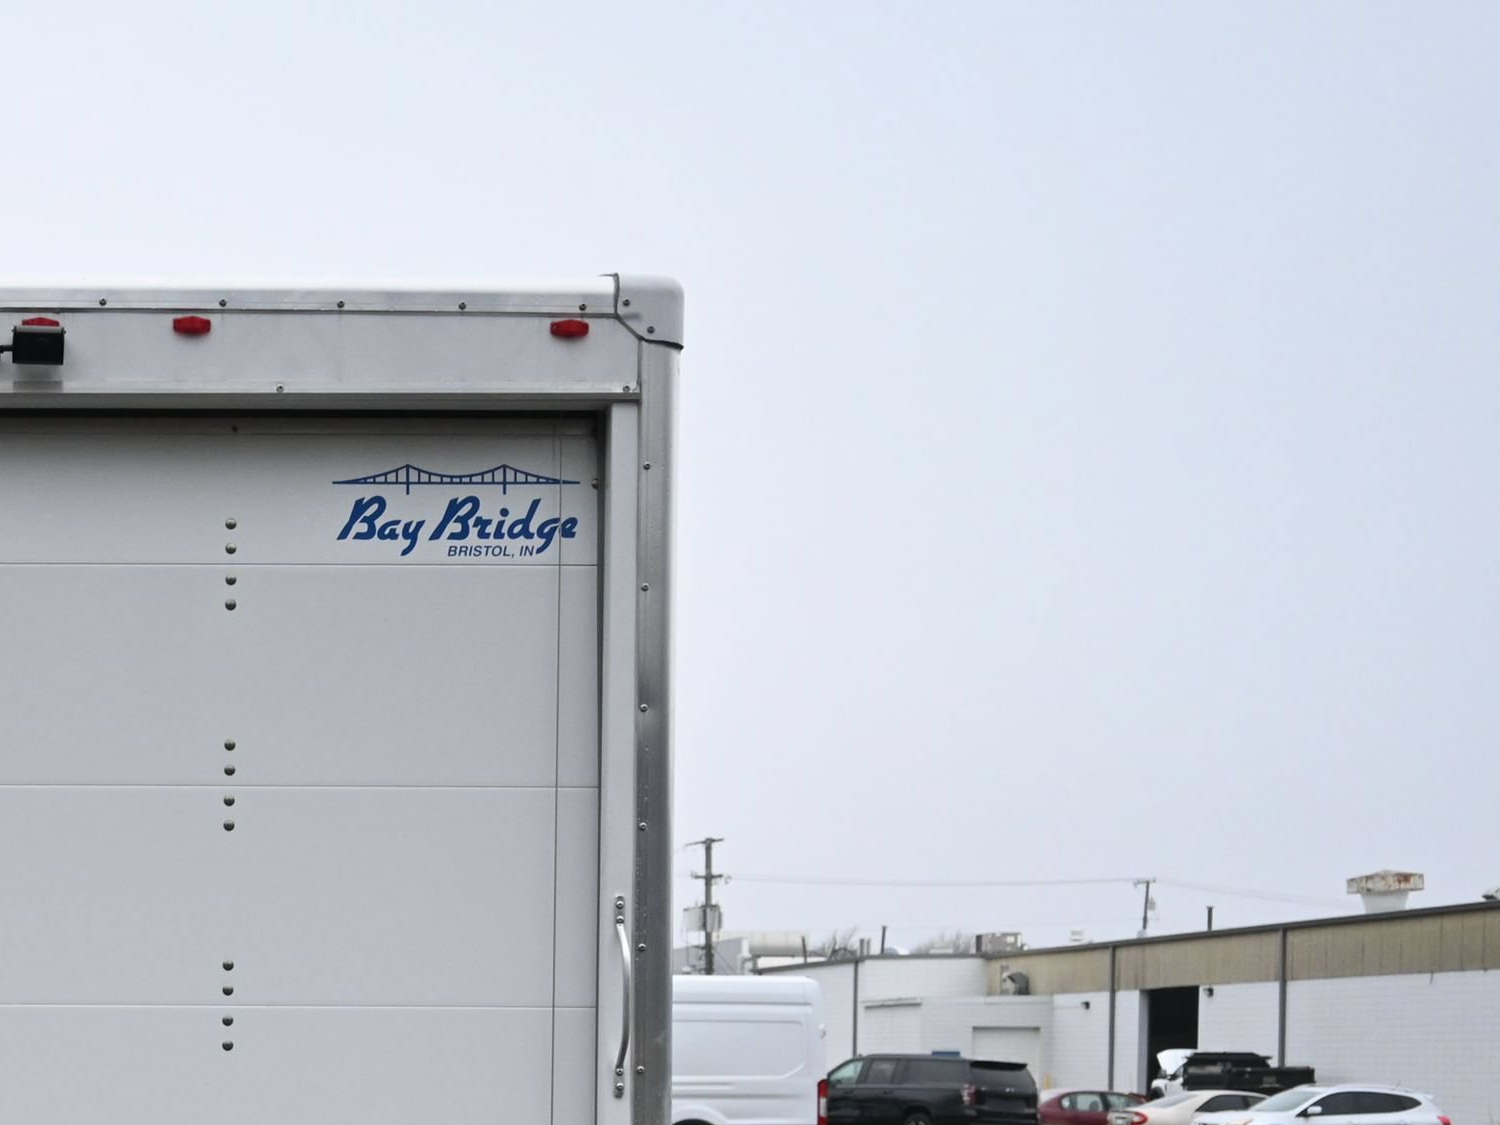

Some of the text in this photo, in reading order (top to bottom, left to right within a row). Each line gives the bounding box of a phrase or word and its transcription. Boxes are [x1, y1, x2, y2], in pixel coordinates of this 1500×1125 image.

[337, 495, 578, 556] Bay Bridge
[447, 545, 534, 558] BRISTOL, IN
